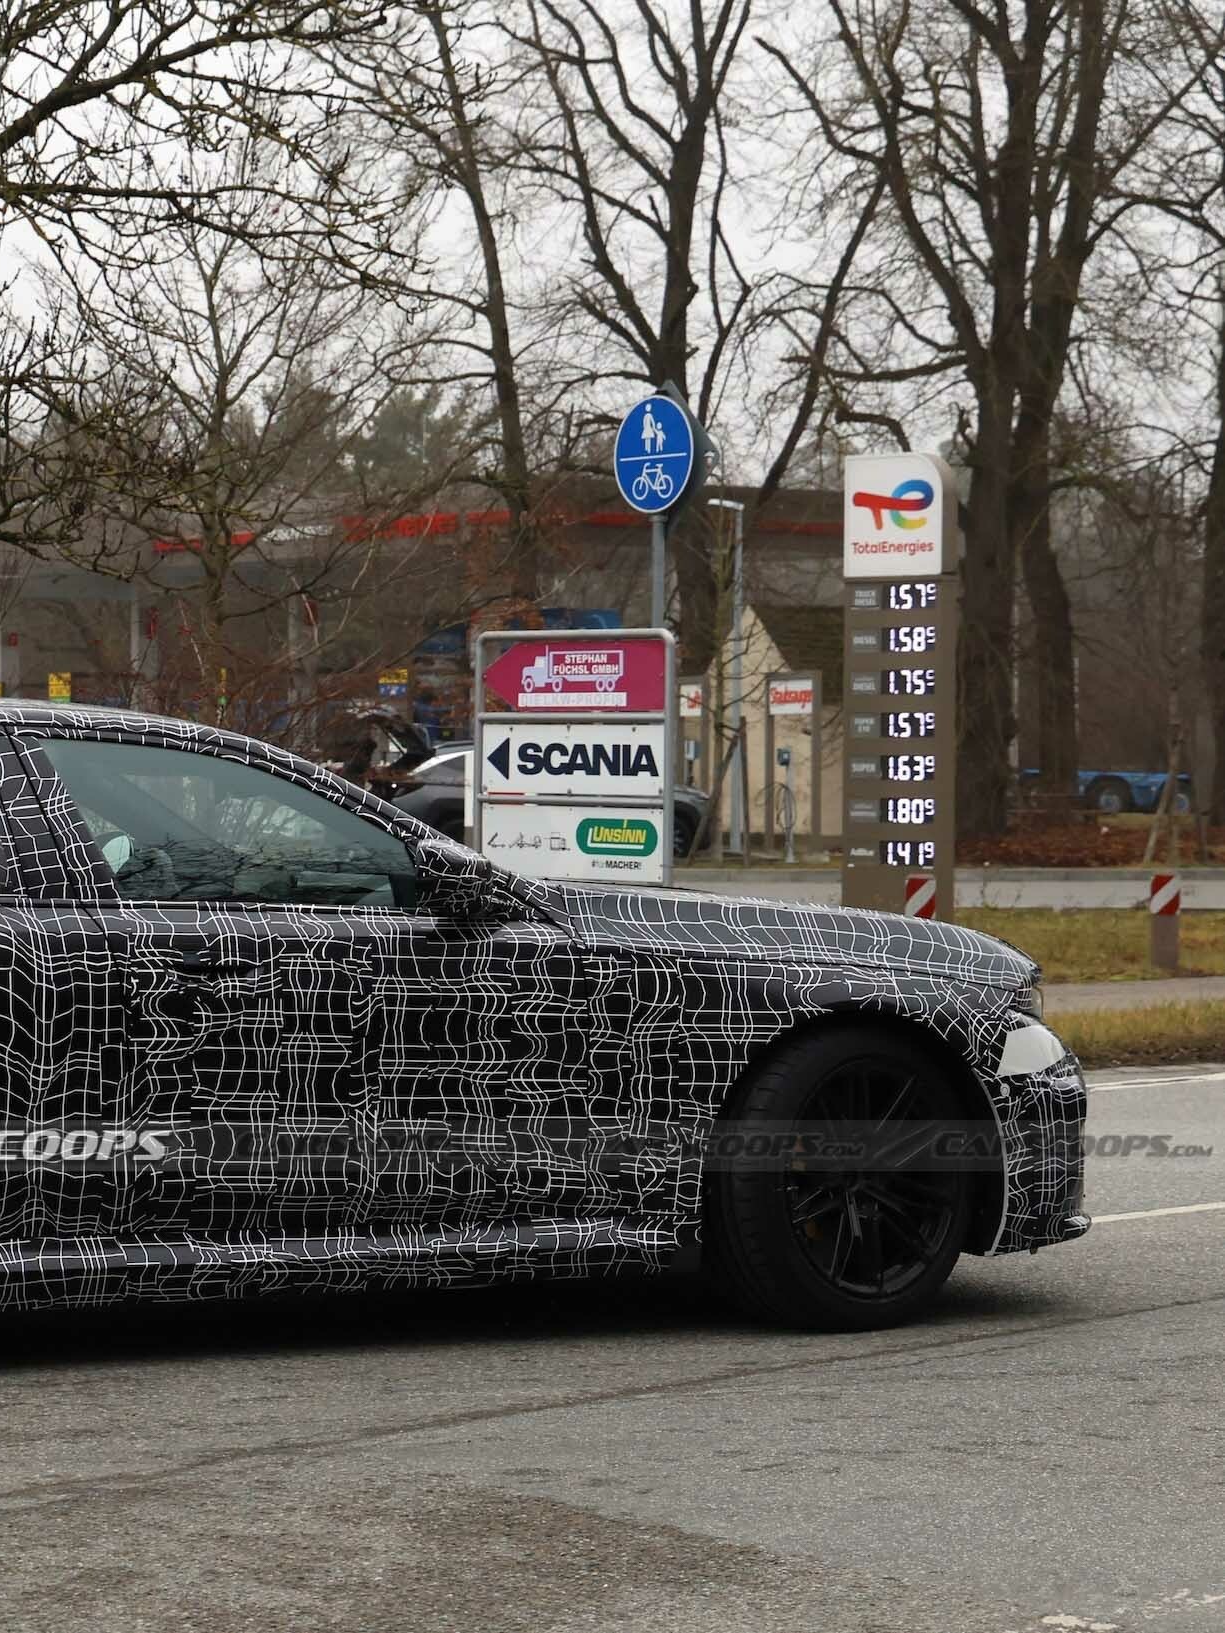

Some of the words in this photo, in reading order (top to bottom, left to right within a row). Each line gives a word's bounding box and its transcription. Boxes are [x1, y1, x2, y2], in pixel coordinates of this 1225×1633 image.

[852, 539, 935, 555] TotalEnergies
[564, 653, 608, 664] STEPHAN
[554, 663, 590, 675] FÜCHSL
[591, 664, 619, 674] GMBH
[517, 742, 659, 776] SCANIA
